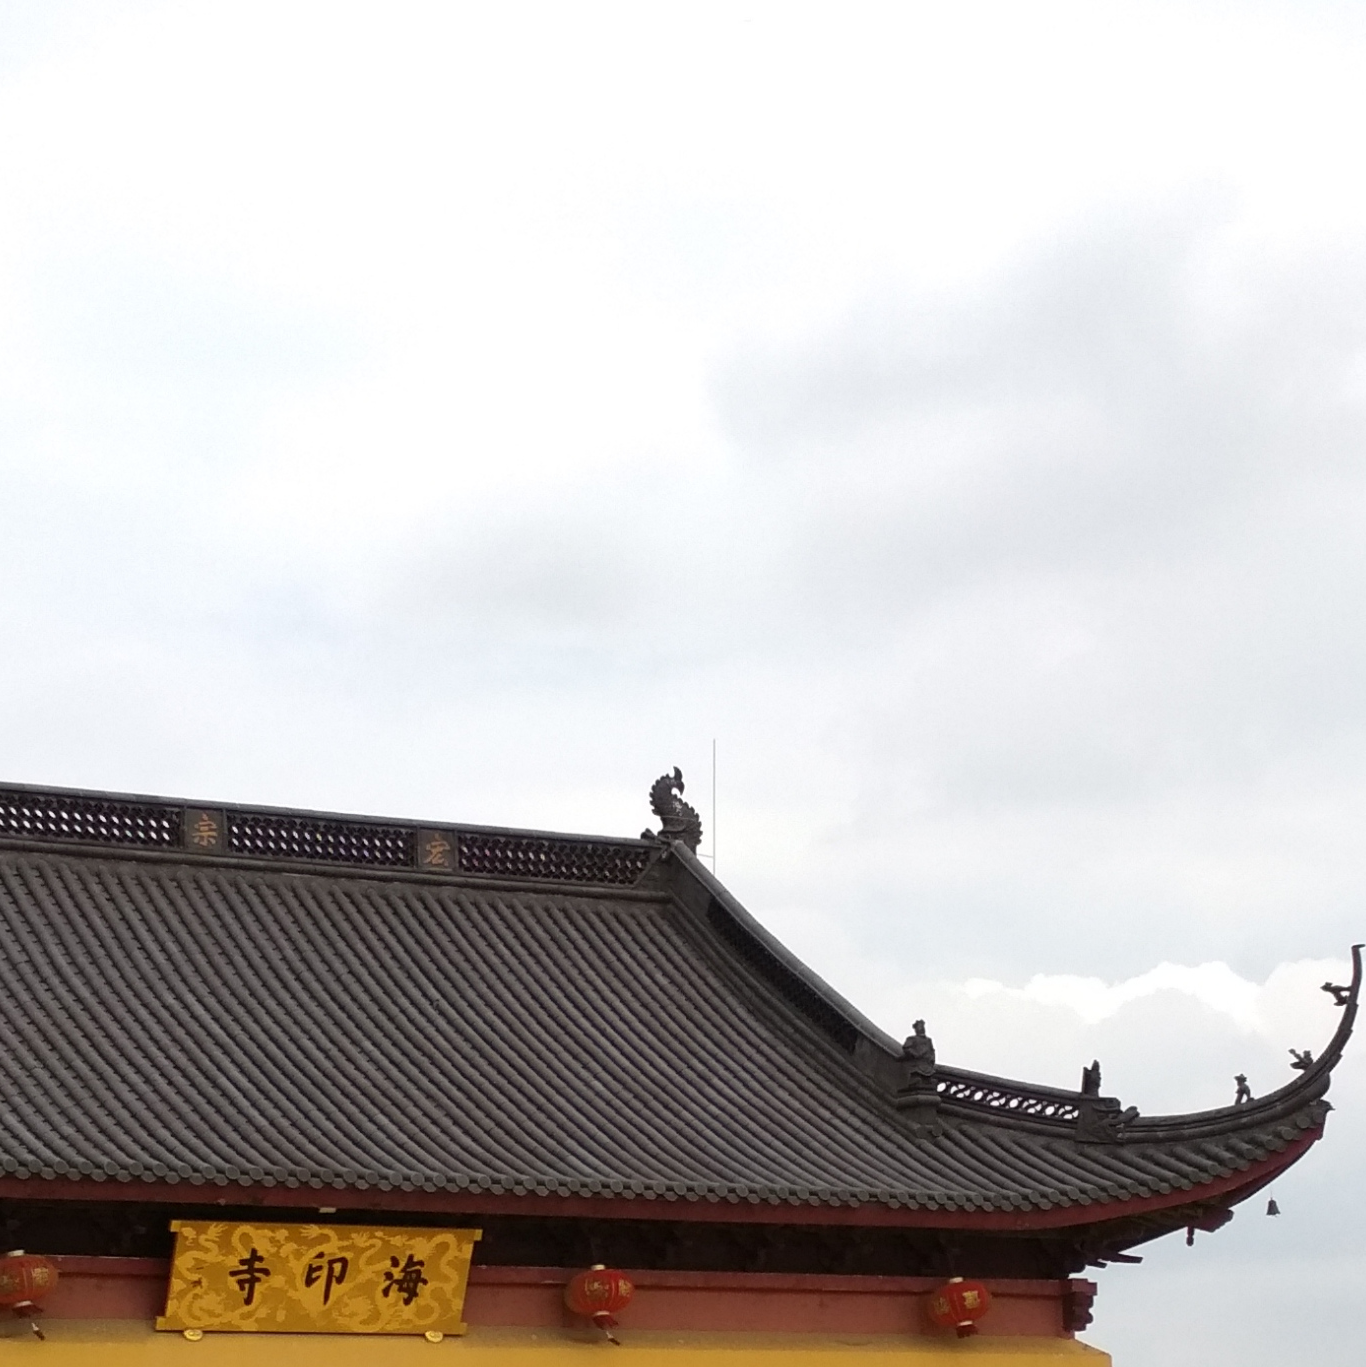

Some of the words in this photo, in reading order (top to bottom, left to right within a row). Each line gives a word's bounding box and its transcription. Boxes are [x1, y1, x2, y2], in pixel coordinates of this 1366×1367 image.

[192, 813, 218, 847] 宗
[228, 1248, 429, 1306] 海印寺
